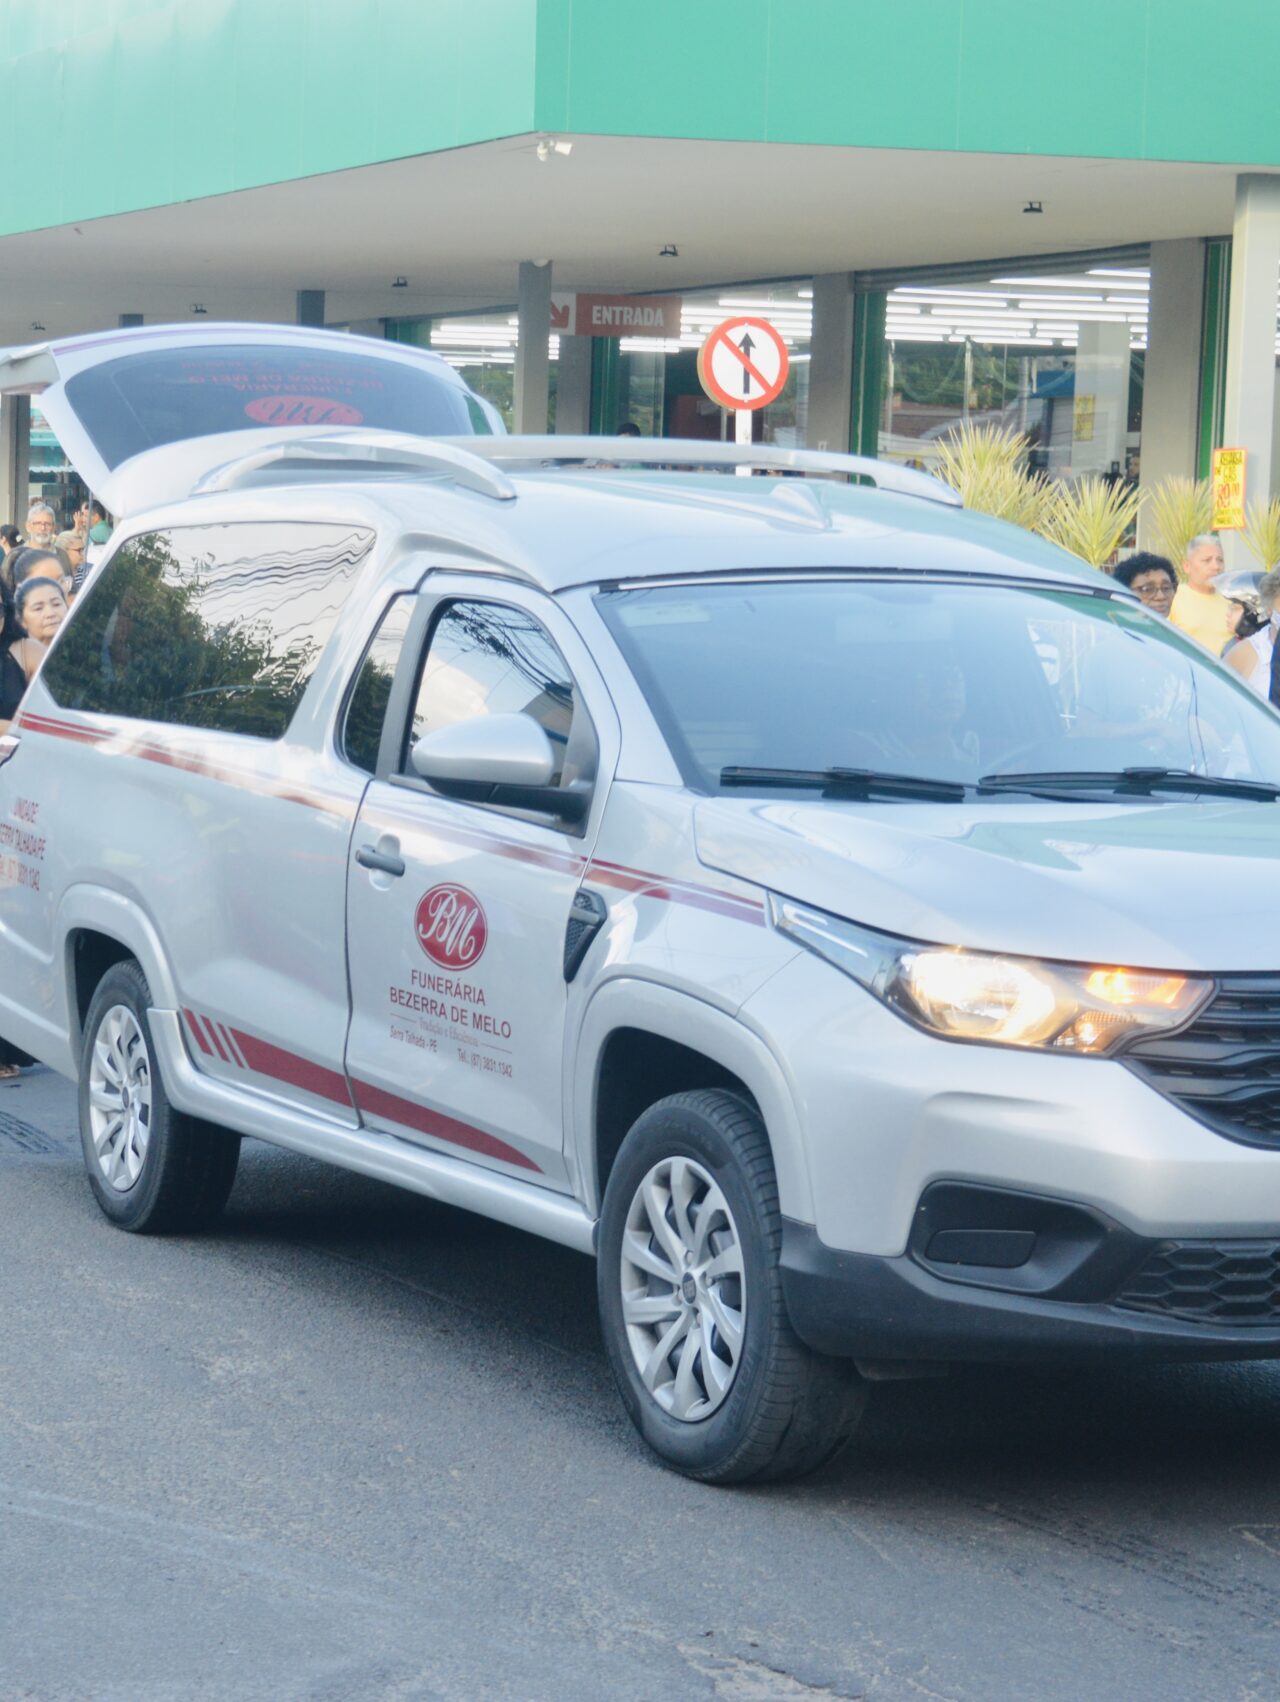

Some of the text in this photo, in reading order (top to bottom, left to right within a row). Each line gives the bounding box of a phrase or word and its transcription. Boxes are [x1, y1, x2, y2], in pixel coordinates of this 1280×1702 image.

[592, 306, 663, 327] ENTRADA
[411, 968, 486, 1007] FUNERÁRIA
[389, 986, 512, 1039] BEZERRA DE MELO
[390, 1024, 404, 1041] Serra
